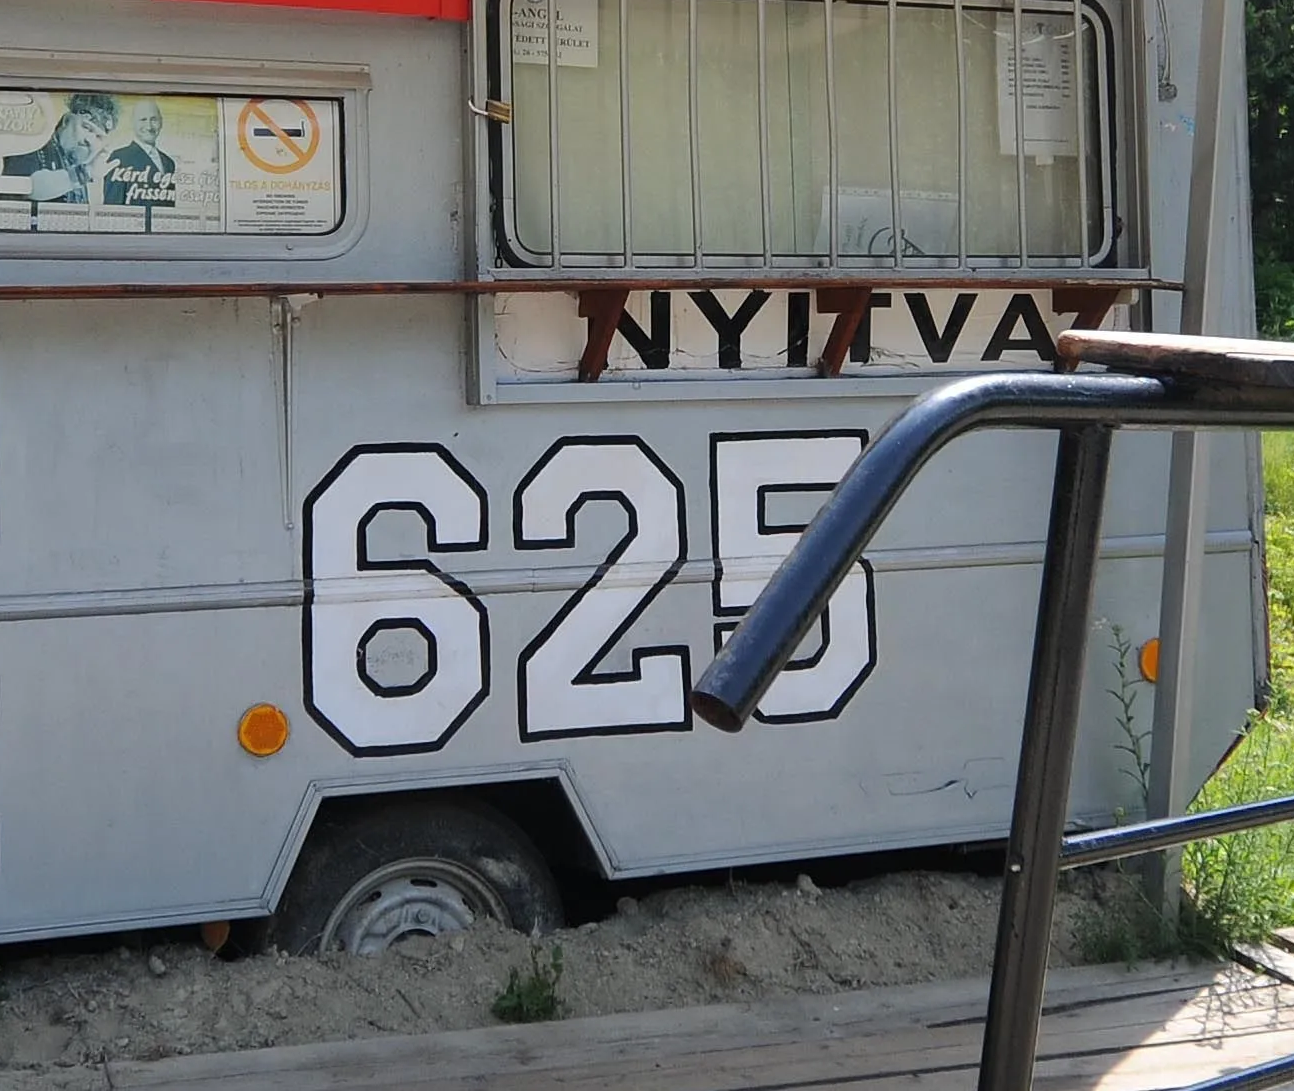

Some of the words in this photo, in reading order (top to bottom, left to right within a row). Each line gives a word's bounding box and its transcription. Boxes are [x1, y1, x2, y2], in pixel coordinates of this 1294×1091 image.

[111, 164, 152, 183] Kérd
[229, 179, 258, 190] TILOS
[260, 180, 268, 190] A
[125, 183, 176, 205] frissen
[587, 289, 1059, 371] NYITVA
[302, 428, 877, 757] 625
